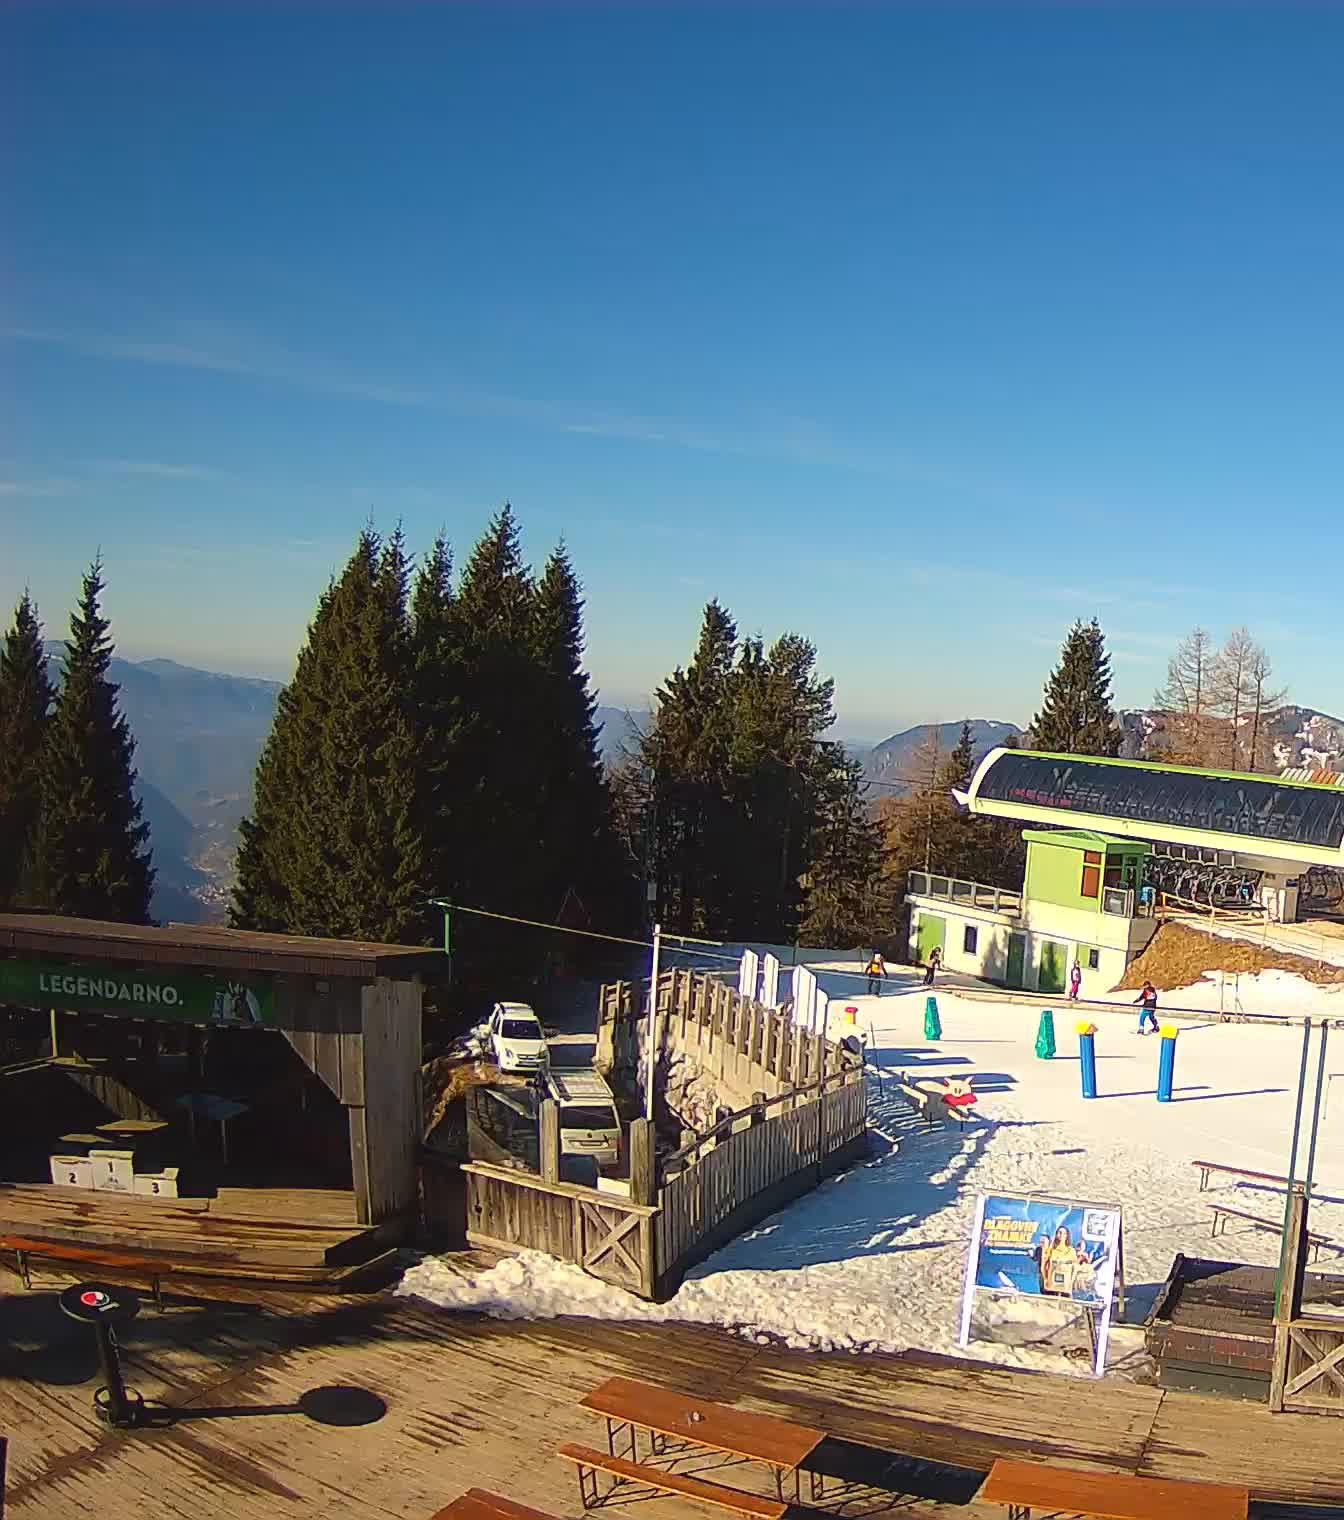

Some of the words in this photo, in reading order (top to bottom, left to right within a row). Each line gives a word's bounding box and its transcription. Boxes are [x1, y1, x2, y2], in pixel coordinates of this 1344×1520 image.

[39, 974, 183, 1005] LEGENDARNO.
[108, 1161, 114, 1173] 1
[68, 1172, 77, 1184] 2
[151, 1182, 160, 1194] 3
